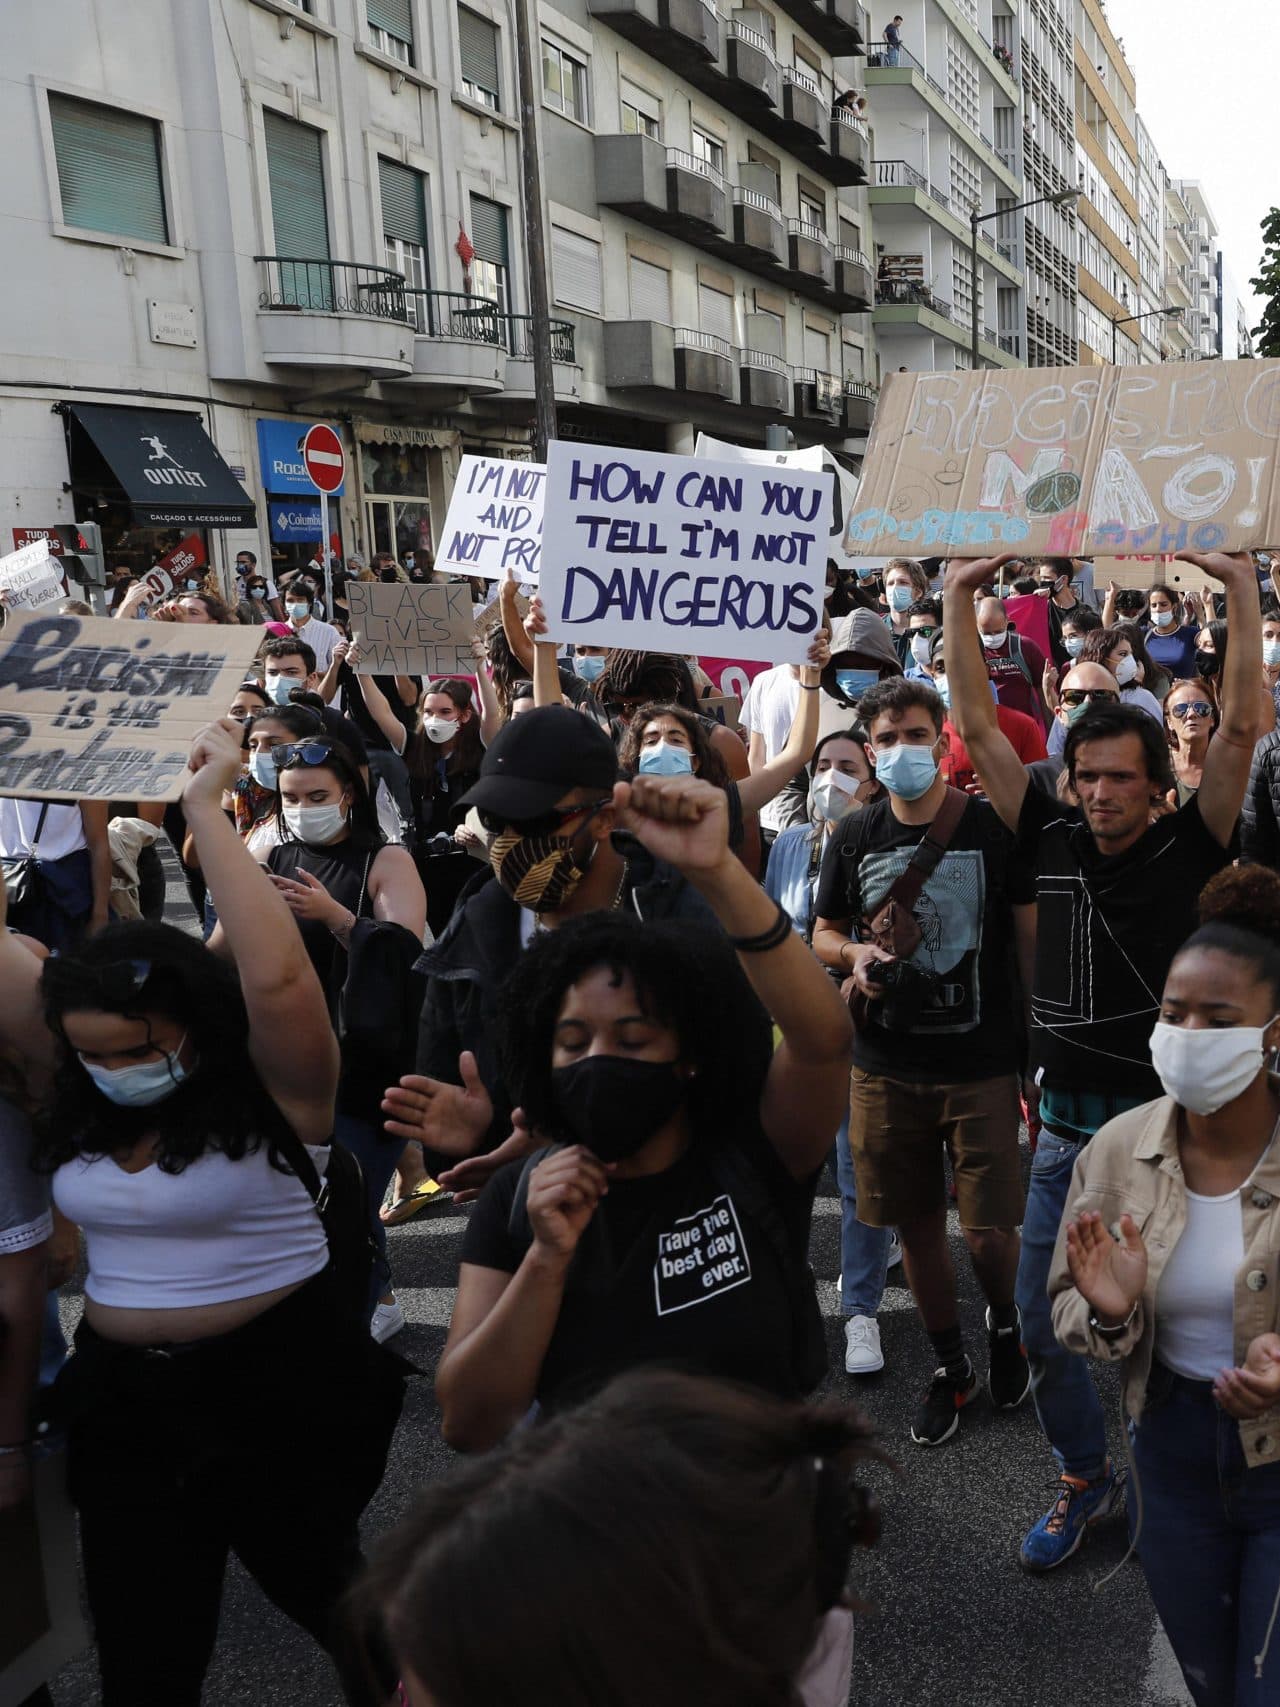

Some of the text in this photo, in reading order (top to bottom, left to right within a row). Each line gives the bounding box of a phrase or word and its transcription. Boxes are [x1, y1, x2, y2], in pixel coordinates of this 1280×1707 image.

[143, 468, 207, 488] OUTLET
[466, 460, 545, 500] I'M NOT
[569, 459, 666, 504] HOW
[675, 471, 743, 512] CAN
[761, 480, 823, 522] YOU
[150, 514, 185, 523] CALÇADO
[195, 514, 242, 523] ACESSÓRIOS
[477, 505, 532, 533] AND
[25, 530, 49, 539] TUDO
[446, 533, 499, 562] NOT
[576, 515, 816, 566] TELL I'M NOT
[171, 554, 195, 577] SALDOS
[350, 583, 464, 620] BLACK
[562, 566, 818, 634] DANGEROUS
[364, 617, 450, 643] LIVES
[356, 644, 476, 674] MATTER
[52, 695, 97, 729] is
[661, 1232, 737, 1278] best day
[702, 1256, 745, 1288] ever.
